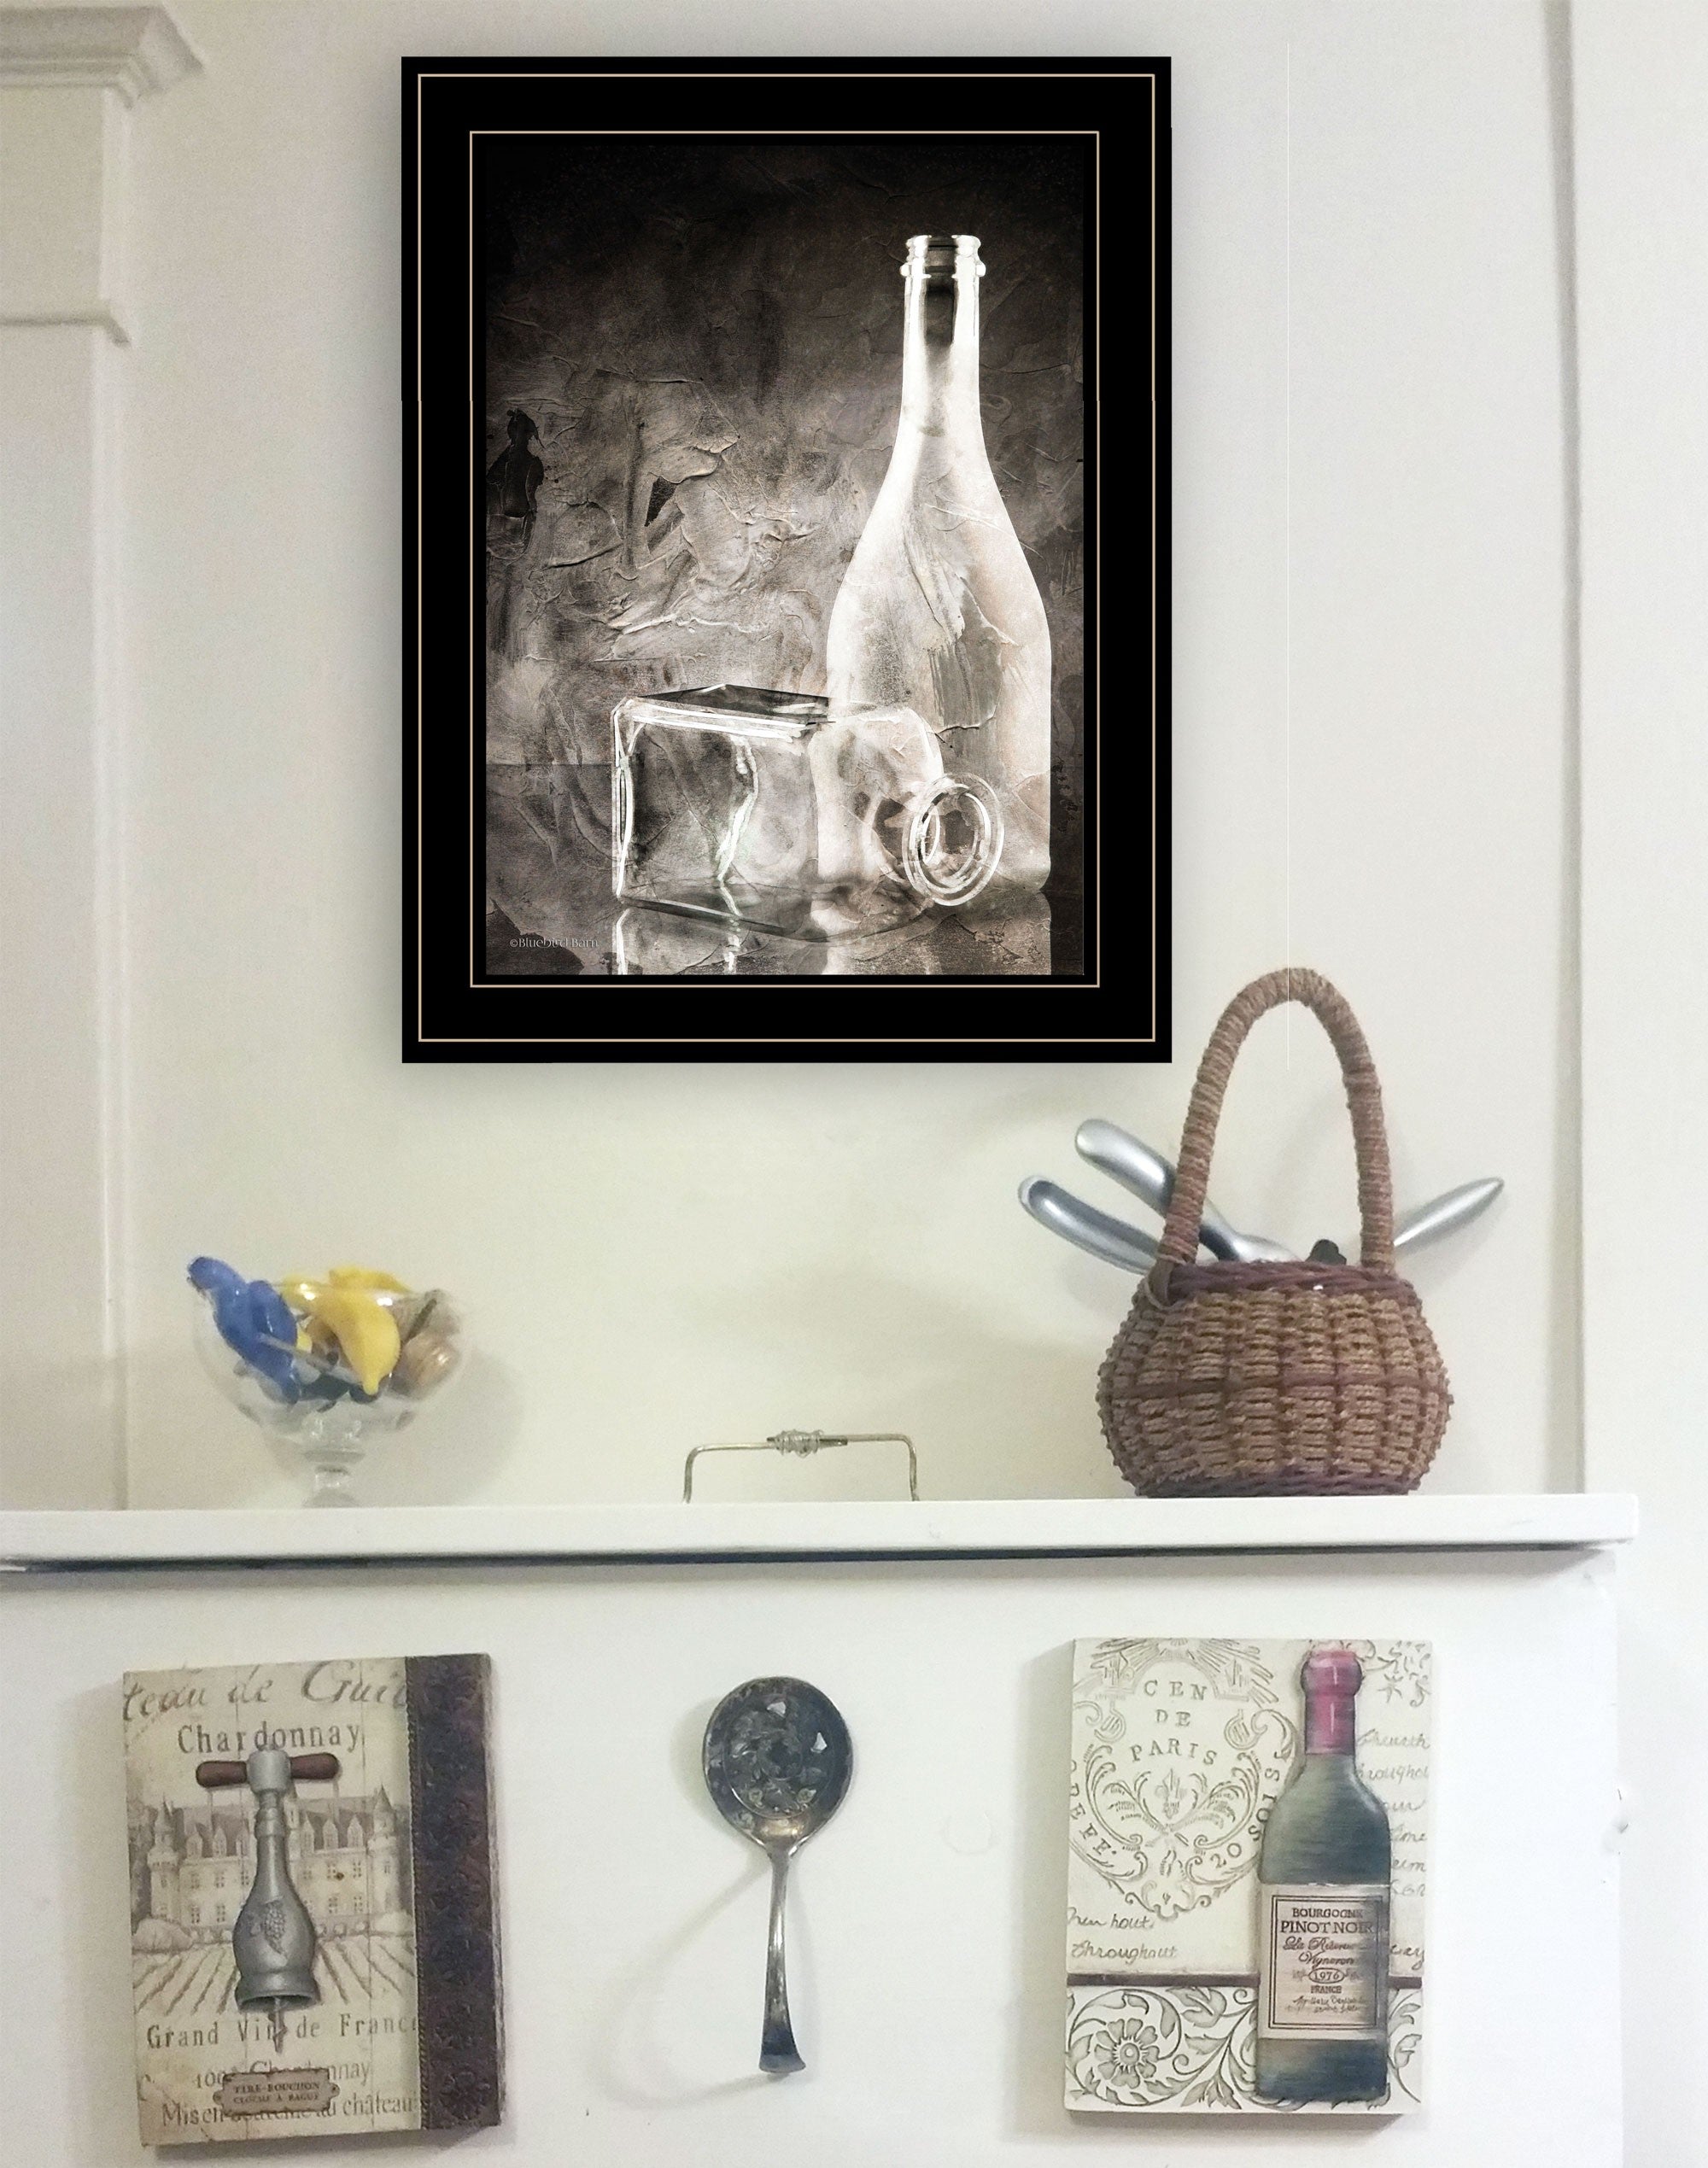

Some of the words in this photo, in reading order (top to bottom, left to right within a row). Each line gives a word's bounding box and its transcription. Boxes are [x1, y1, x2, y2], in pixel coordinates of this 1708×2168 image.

[571, 937, 598, 948] Barn
[227, 1664, 273, 1703] de
[1155, 1709, 1191, 1727] DE
[178, 1721, 360, 1755] Chardonnay
[1130, 1738, 1218, 1765] PARIS
[1280, 1920, 1331, 1933] PINOT
[1334, 1921, 1374, 1934] NOIR
[1313, 1971, 1340, 1981] 1976
[1310, 1985, 1342, 1994] FRANCE
[147, 2021, 218, 2048] Grand
[238, 2018, 277, 2042] Vin
[296, 2015, 320, 2039] de
